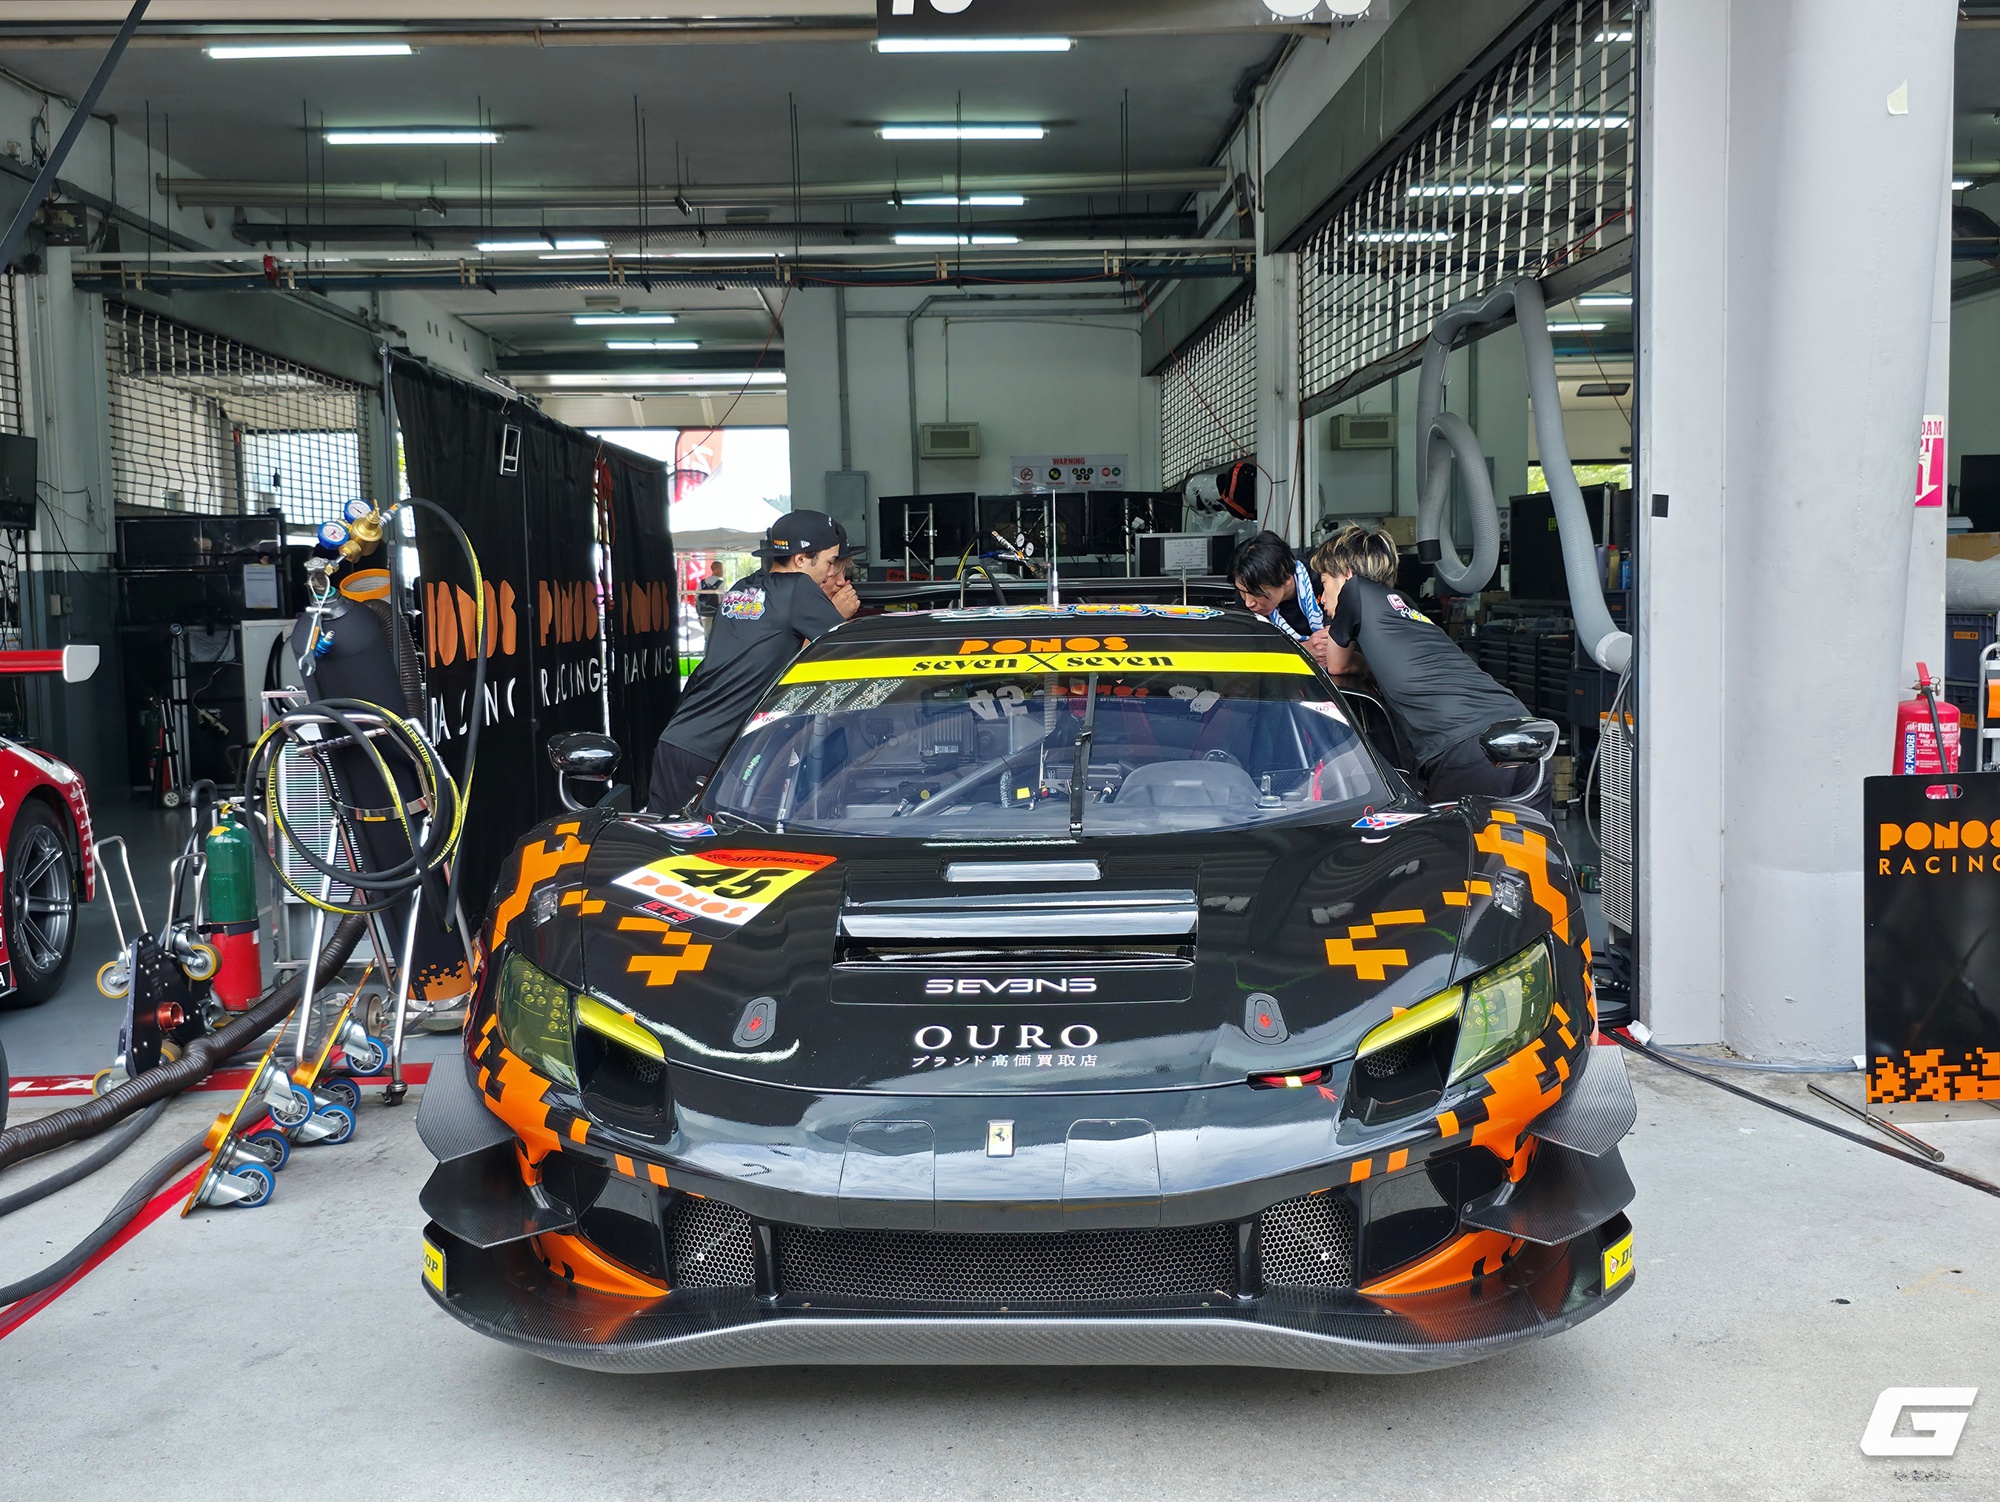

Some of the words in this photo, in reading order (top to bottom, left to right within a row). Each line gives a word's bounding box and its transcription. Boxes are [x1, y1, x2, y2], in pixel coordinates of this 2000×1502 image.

[1052, 457, 1086, 466] WARNING
[958, 637, 1129, 655] PONOS
[911, 657, 1019, 672] seven
[1066, 653, 1175, 669] seven
[669, 868, 795, 900] 45
[631, 875, 749, 919] PONOS
[643, 901, 696, 922] ETS
[914, 1024, 1099, 1050] OURO
[911, 1053, 1098, 1068] ブランド高価買取店
